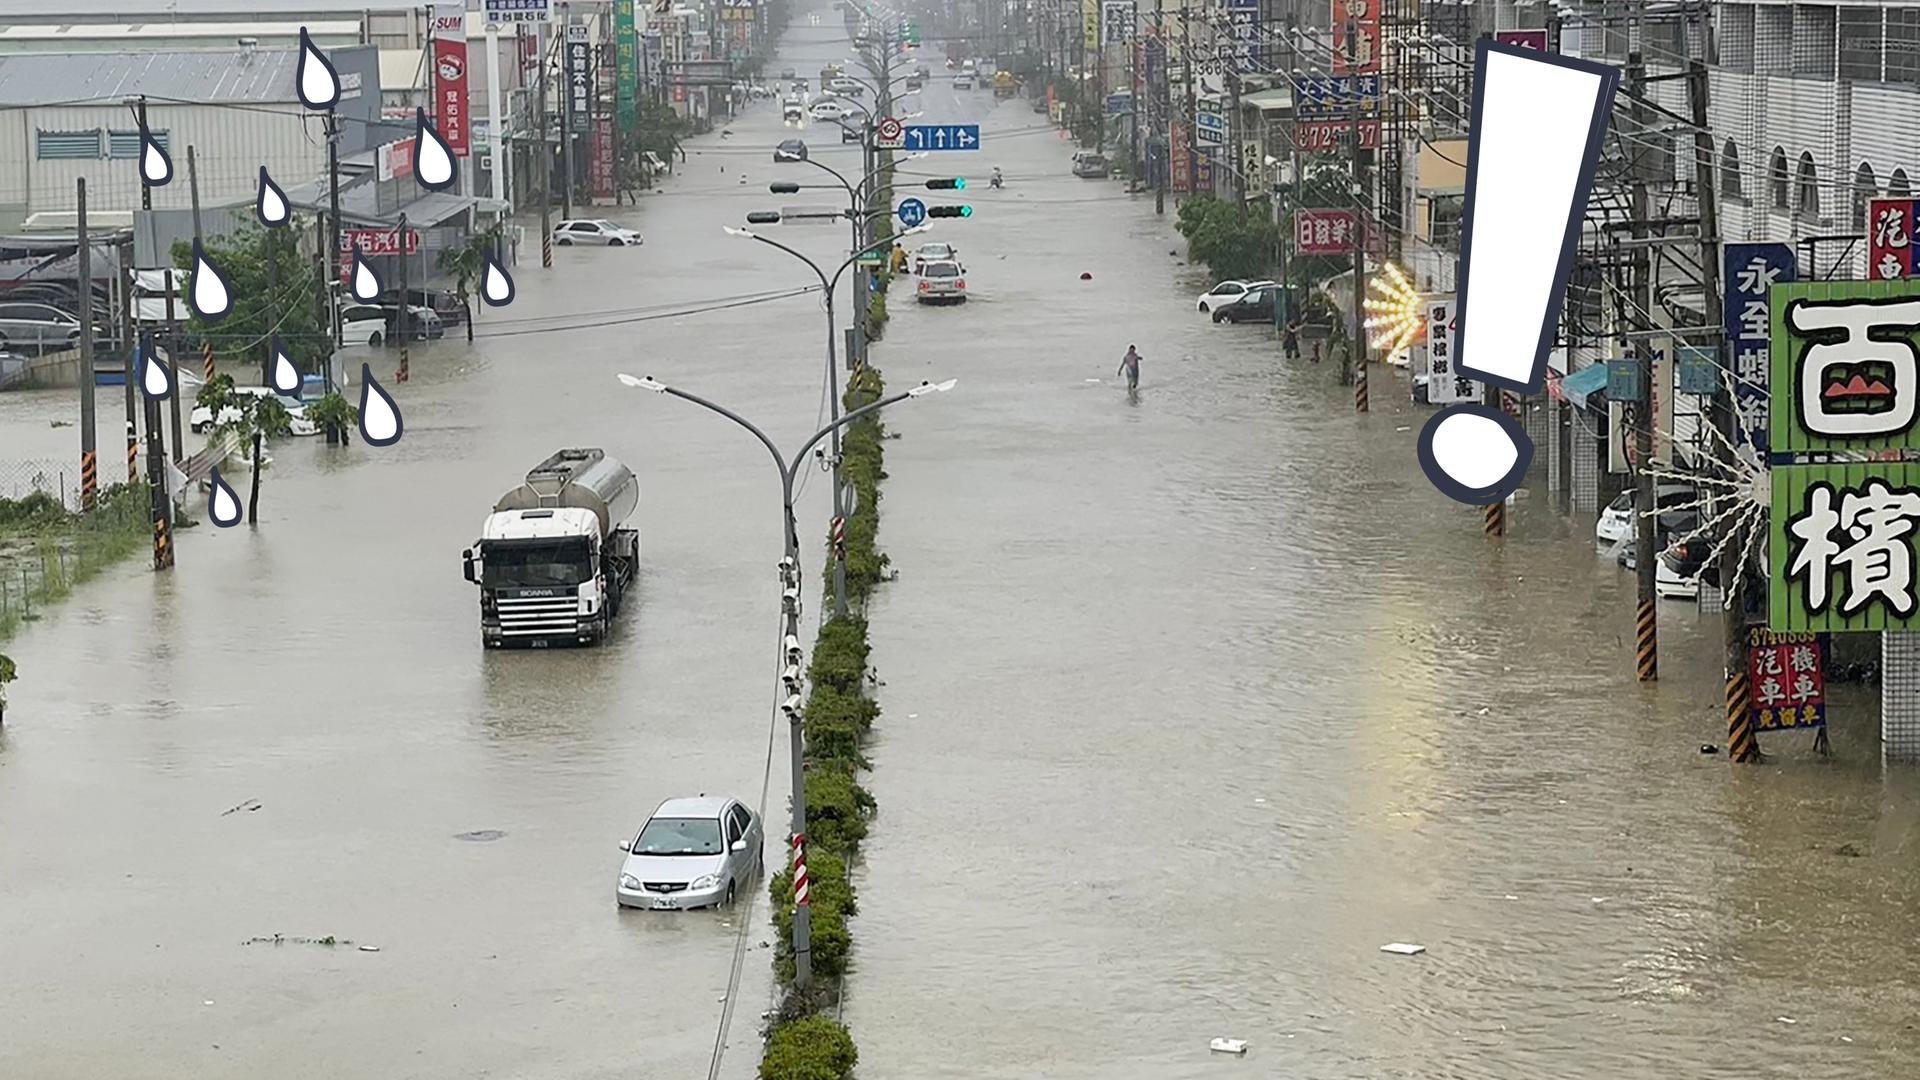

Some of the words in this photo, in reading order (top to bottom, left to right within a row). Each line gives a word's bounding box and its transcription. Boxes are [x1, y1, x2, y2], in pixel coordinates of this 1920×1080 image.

[436, 16, 462, 29] SUM
[1790, 300, 1920, 436] 百
[520, 589, 553, 597] SCANIA
[1757, 648, 1786, 706] 汽車
[1790, 645, 1819, 703] 機車
[1760, 704, 1820, 728] 免留車
